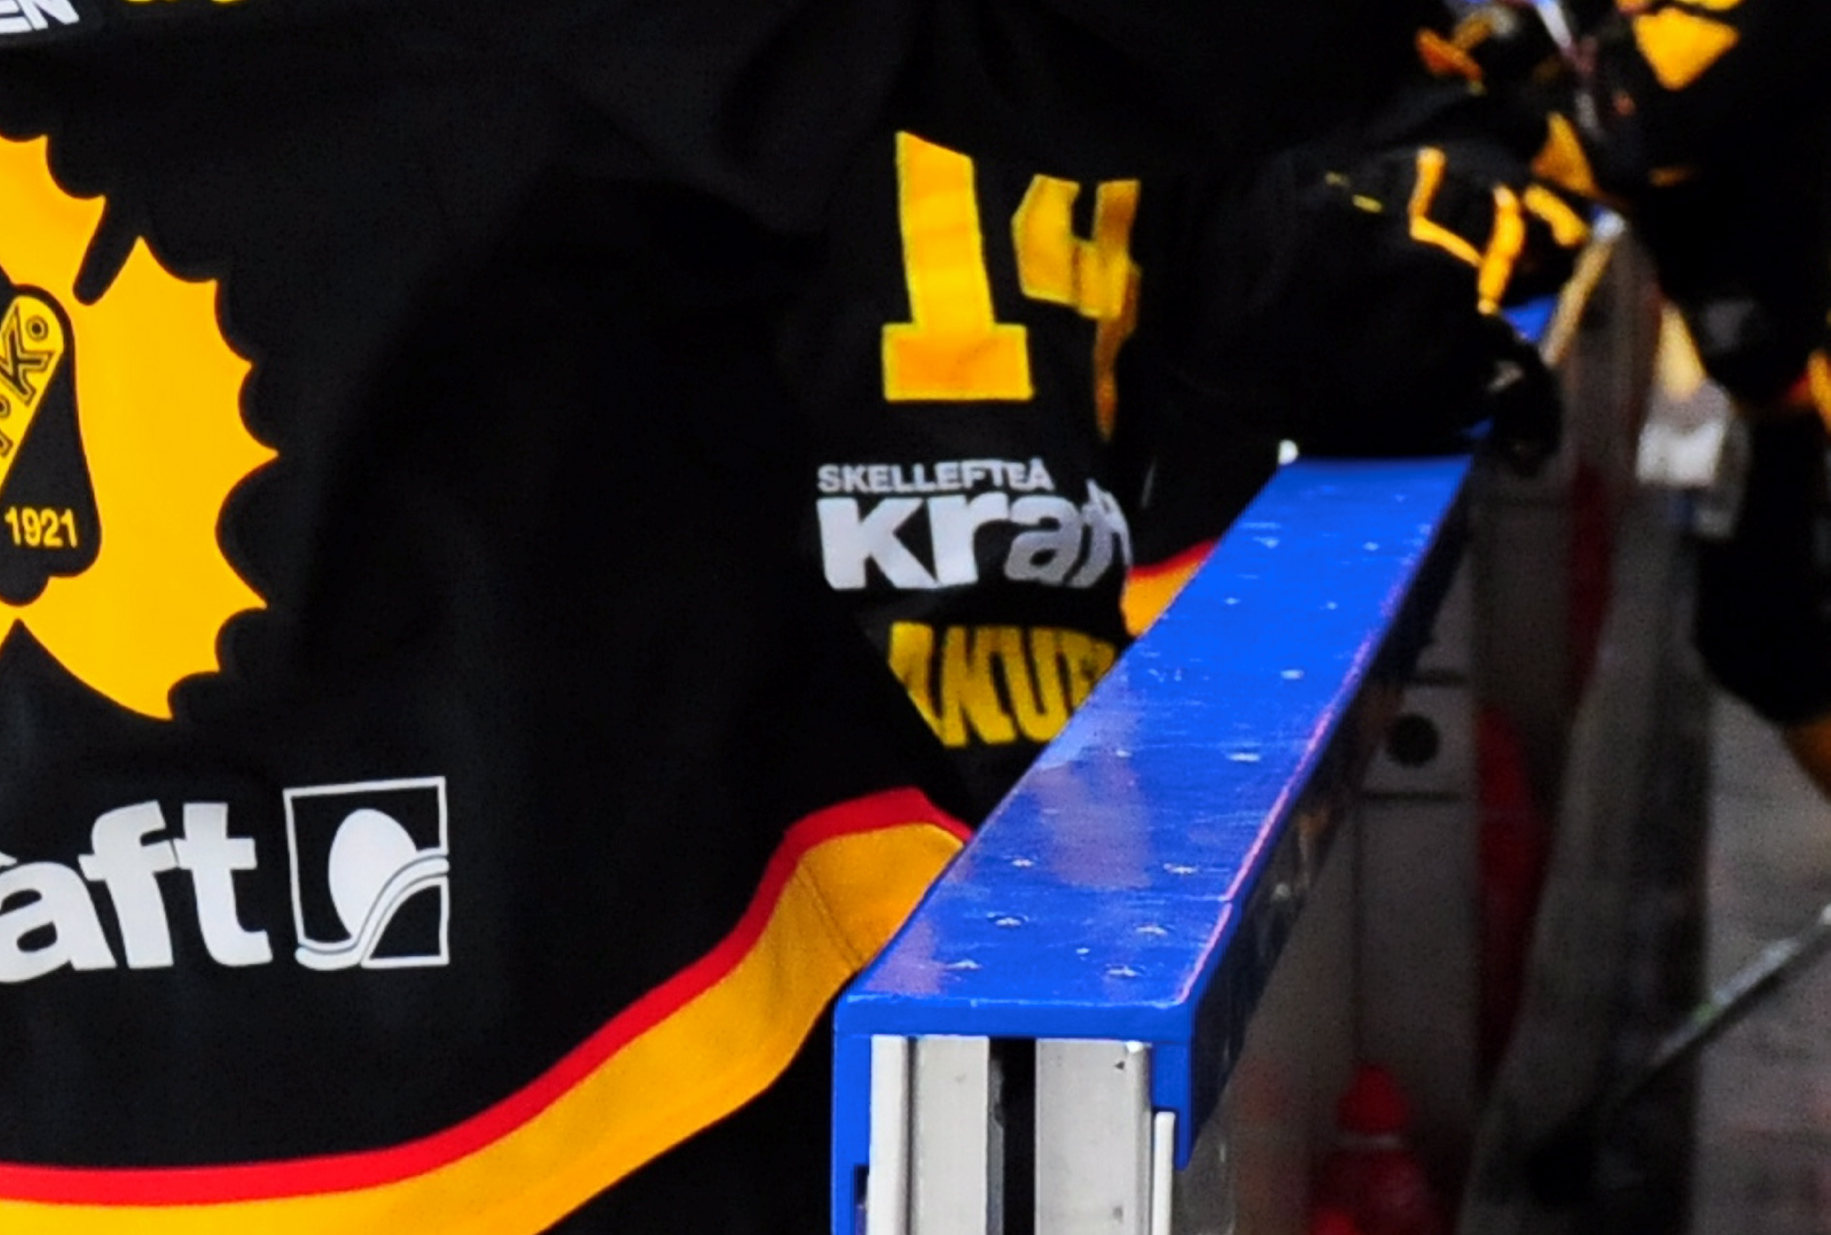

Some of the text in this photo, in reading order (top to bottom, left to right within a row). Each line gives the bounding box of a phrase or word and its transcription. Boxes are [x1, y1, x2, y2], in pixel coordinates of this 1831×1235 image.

[881, 129, 1142, 443] 14
[817, 456, 1056, 494] SKELLEFTEÅ
[3, 505, 79, 550] 1921
